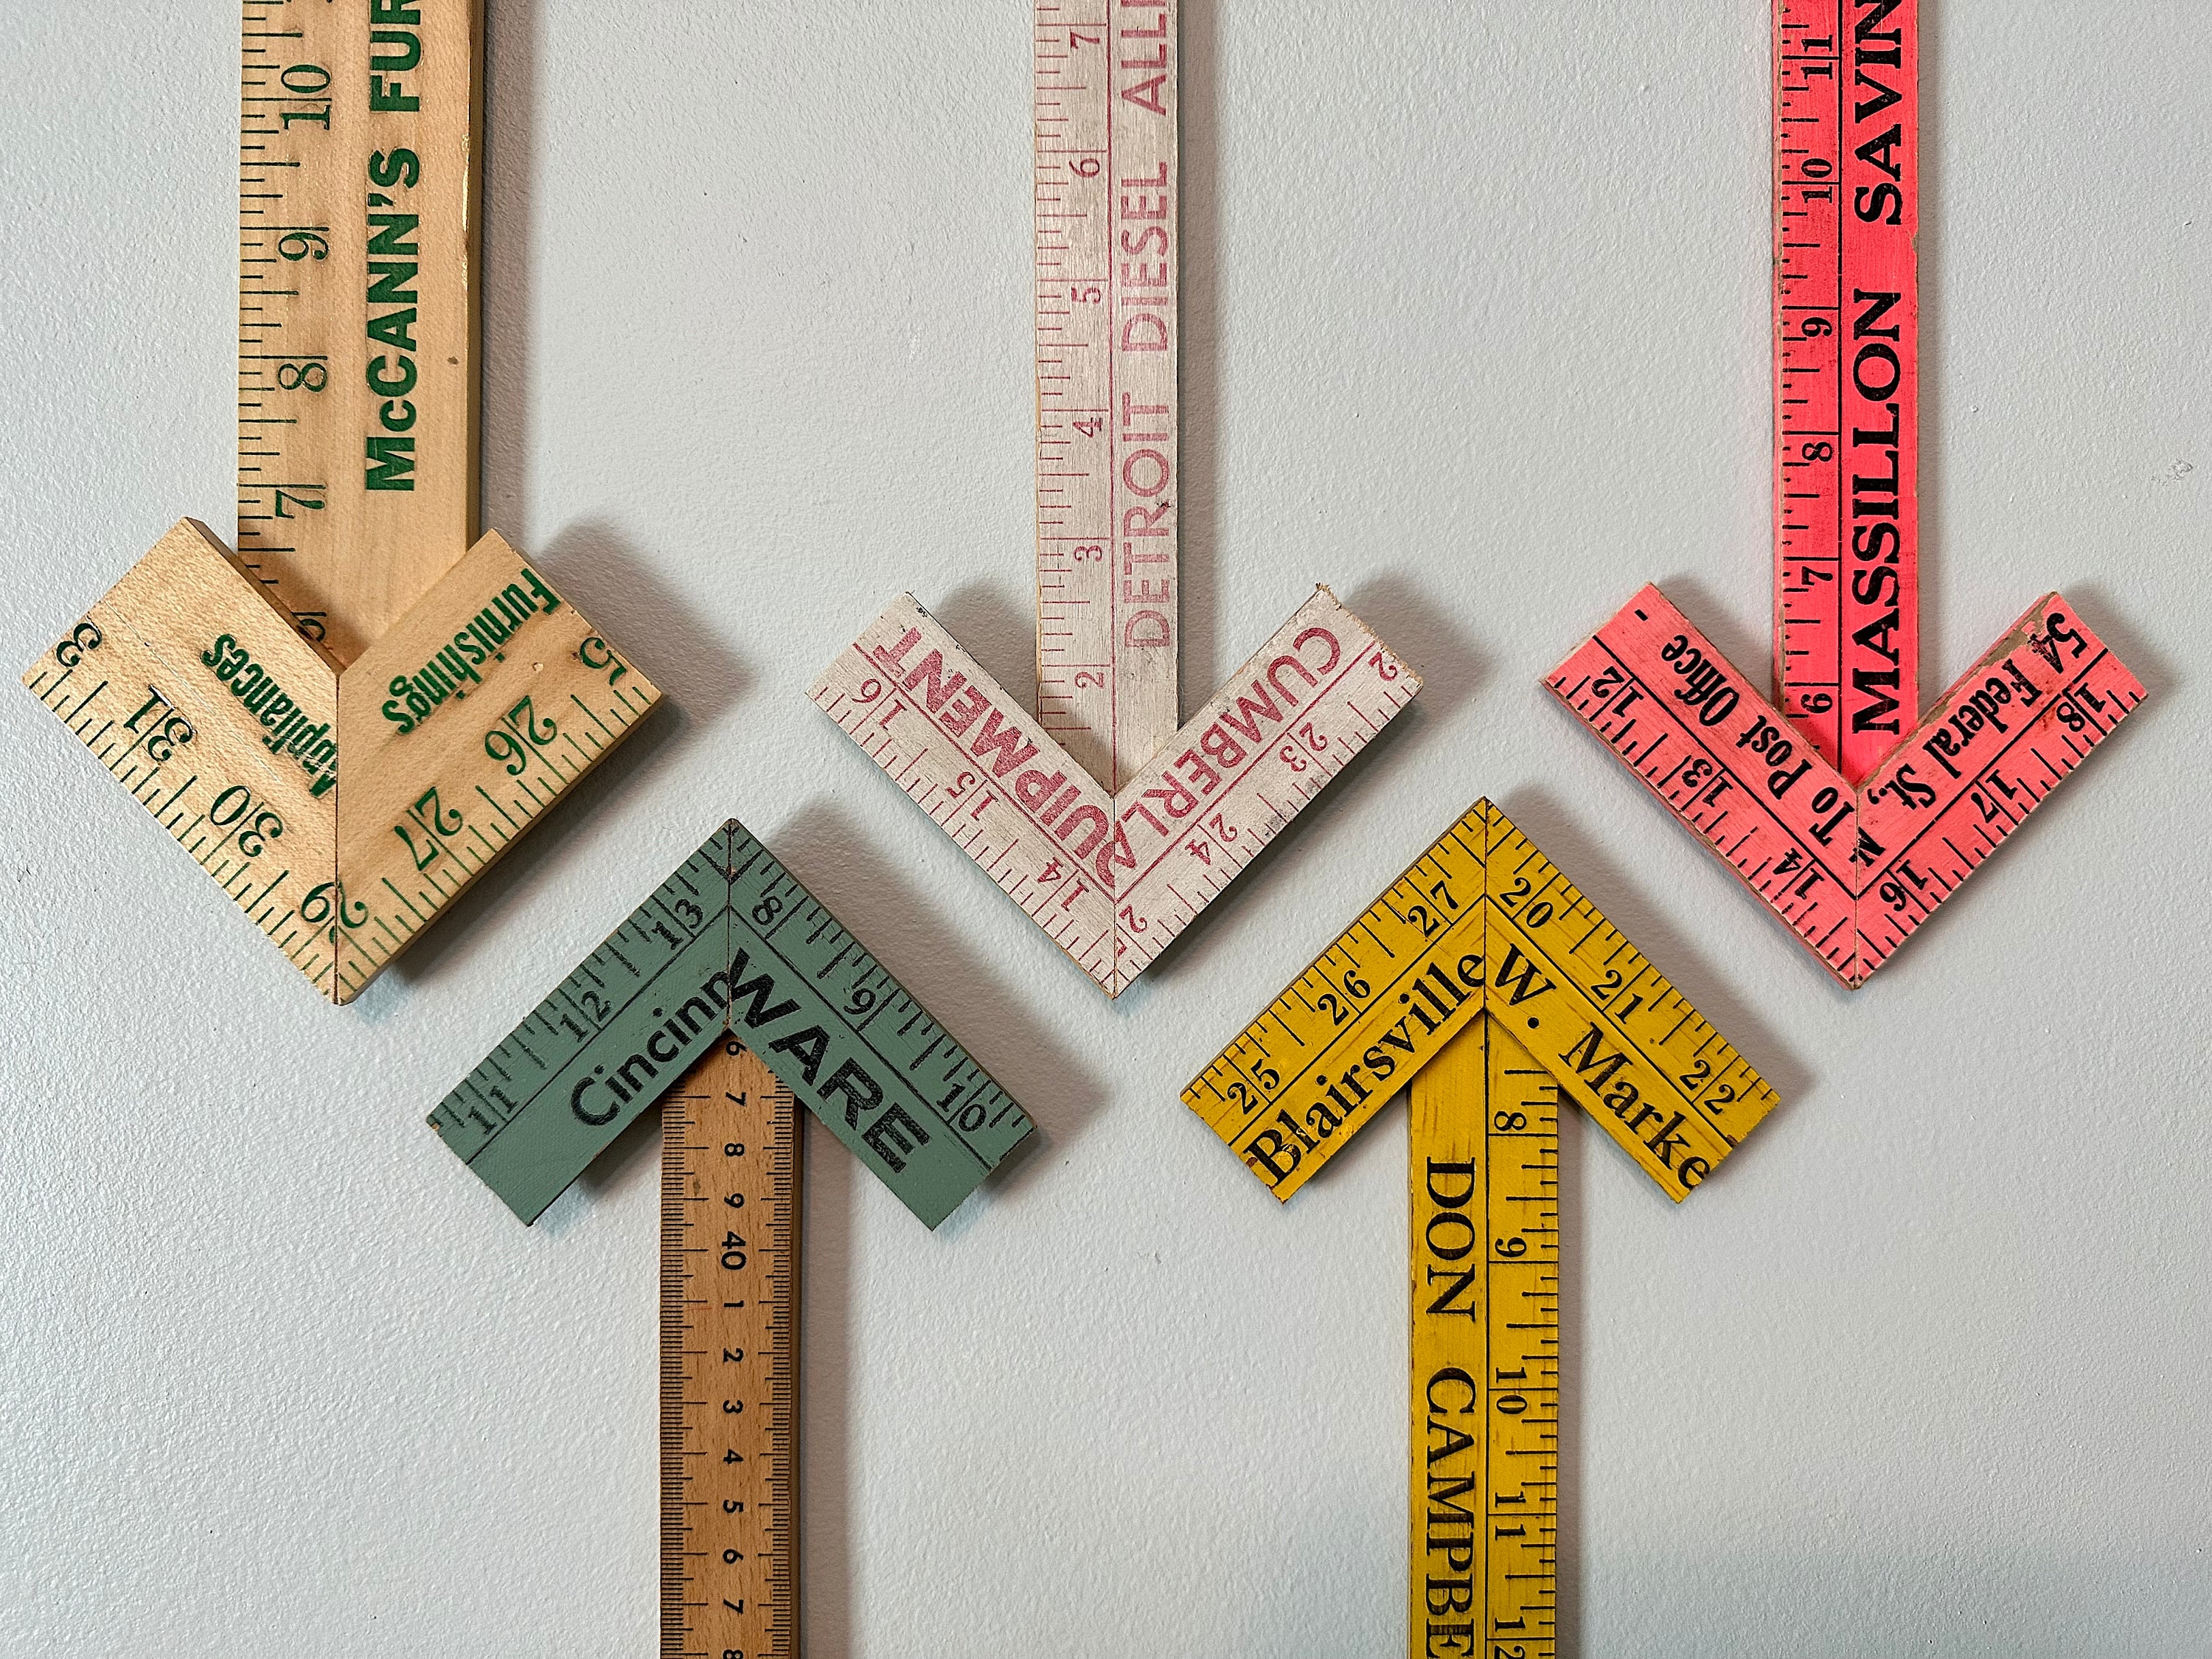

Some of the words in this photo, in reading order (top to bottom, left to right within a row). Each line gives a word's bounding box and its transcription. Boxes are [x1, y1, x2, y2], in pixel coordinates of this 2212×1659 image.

[1069, 32, 1100, 49] 7
[1801, 35, 1834, 80] 11
[279, 64, 332, 131] 10
[1068, 158, 1100, 178] 6
[1801, 158, 1834, 203] 10
[278, 232, 330, 262] 9
[1120, 161, 1169, 352] DIESEL
[365, 148, 420, 491] McCANN'S
[1071, 287, 1102, 305] 5
[1801, 316, 1833, 338] 9
[276, 363, 328, 392] 8
[1072, 417, 1103, 437] 4
[1801, 442, 1833, 462] 8
[275, 490, 326, 518] 7
[1122, 392, 1171, 647] DETROIT
[1851, 288, 1902, 735] MASSILLON
[1074, 545, 1103, 563] 3
[1801, 566, 1834, 586] 7
[382, 568, 562, 734] Furnishings
[2028, 613, 2087, 674] 54
[852, 678, 908, 731] 16
[1074, 671, 1105, 689] 2
[1591, 667, 1644, 718] 12
[1660, 634, 1740, 727] Office
[1800, 693, 1834, 714] 6
[123, 684, 198, 762] 31
[1922, 658, 2042, 779] Federal
[2056, 682, 2107, 733] 18
[484, 695, 557, 776] 26
[1279, 722, 1329, 772] 23
[1736, 714, 1814, 800] Post
[946, 771, 998, 821] 15
[1682, 758, 1733, 807] 13
[1970, 769, 2018, 824] 17
[209, 785, 283, 858] 30
[394, 787, 463, 871] 27
[1184, 813, 1237, 865] 24
[1809, 786, 1855, 847] To
[1037, 856, 1090, 911] 14
[1773, 848, 1824, 900] 14
[1879, 859, 1929, 912] 16
[651, 898, 703, 950] 13
[751, 895, 783, 926] 8
[1407, 880, 1458, 937] 27
[1500, 877, 1554, 929] 20
[560, 990, 611, 1043] 12
[844, 988, 877, 1015] 9
[1317, 969, 1371, 1026] 26
[1590, 970, 1644, 1025] 21
[725, 1040, 748, 1057] 6
[729, 947, 931, 1174] WARE
[1243, 953, 1485, 1188] Blairsville
[1495, 943, 1557, 1029] W.
[1558, 1020, 1711, 1190] Marke
[467, 1085, 518, 1135] 11
[725, 1091, 747, 1107] 7
[935, 1083, 988, 1133] 10
[1227, 1059, 1280, 1115] 25
[1679, 1059, 1735, 1116] 22
[1494, 1110, 1527, 1131] 8
[724, 1142, 745, 1158] 8
[723, 1192, 745, 1208] 9
[720, 1231, 746, 1270] 40
[1425, 1156, 1475, 1323] DON
[1495, 1237, 1527, 1258] 9
[723, 1299, 744, 1308] 1
[723, 1348, 744, 1363] 2
[723, 1399, 743, 1414] 3
[1495, 1366, 1528, 1414] 10
[723, 1448, 744, 1464] 4
[723, 1500, 744, 1514] 5
[1426, 1367, 1476, 1659] CAMPBE
[1494, 1491, 1526, 1540] 11
[723, 1548, 744, 1564] 6
[723, 1599, 744, 1614] 7
